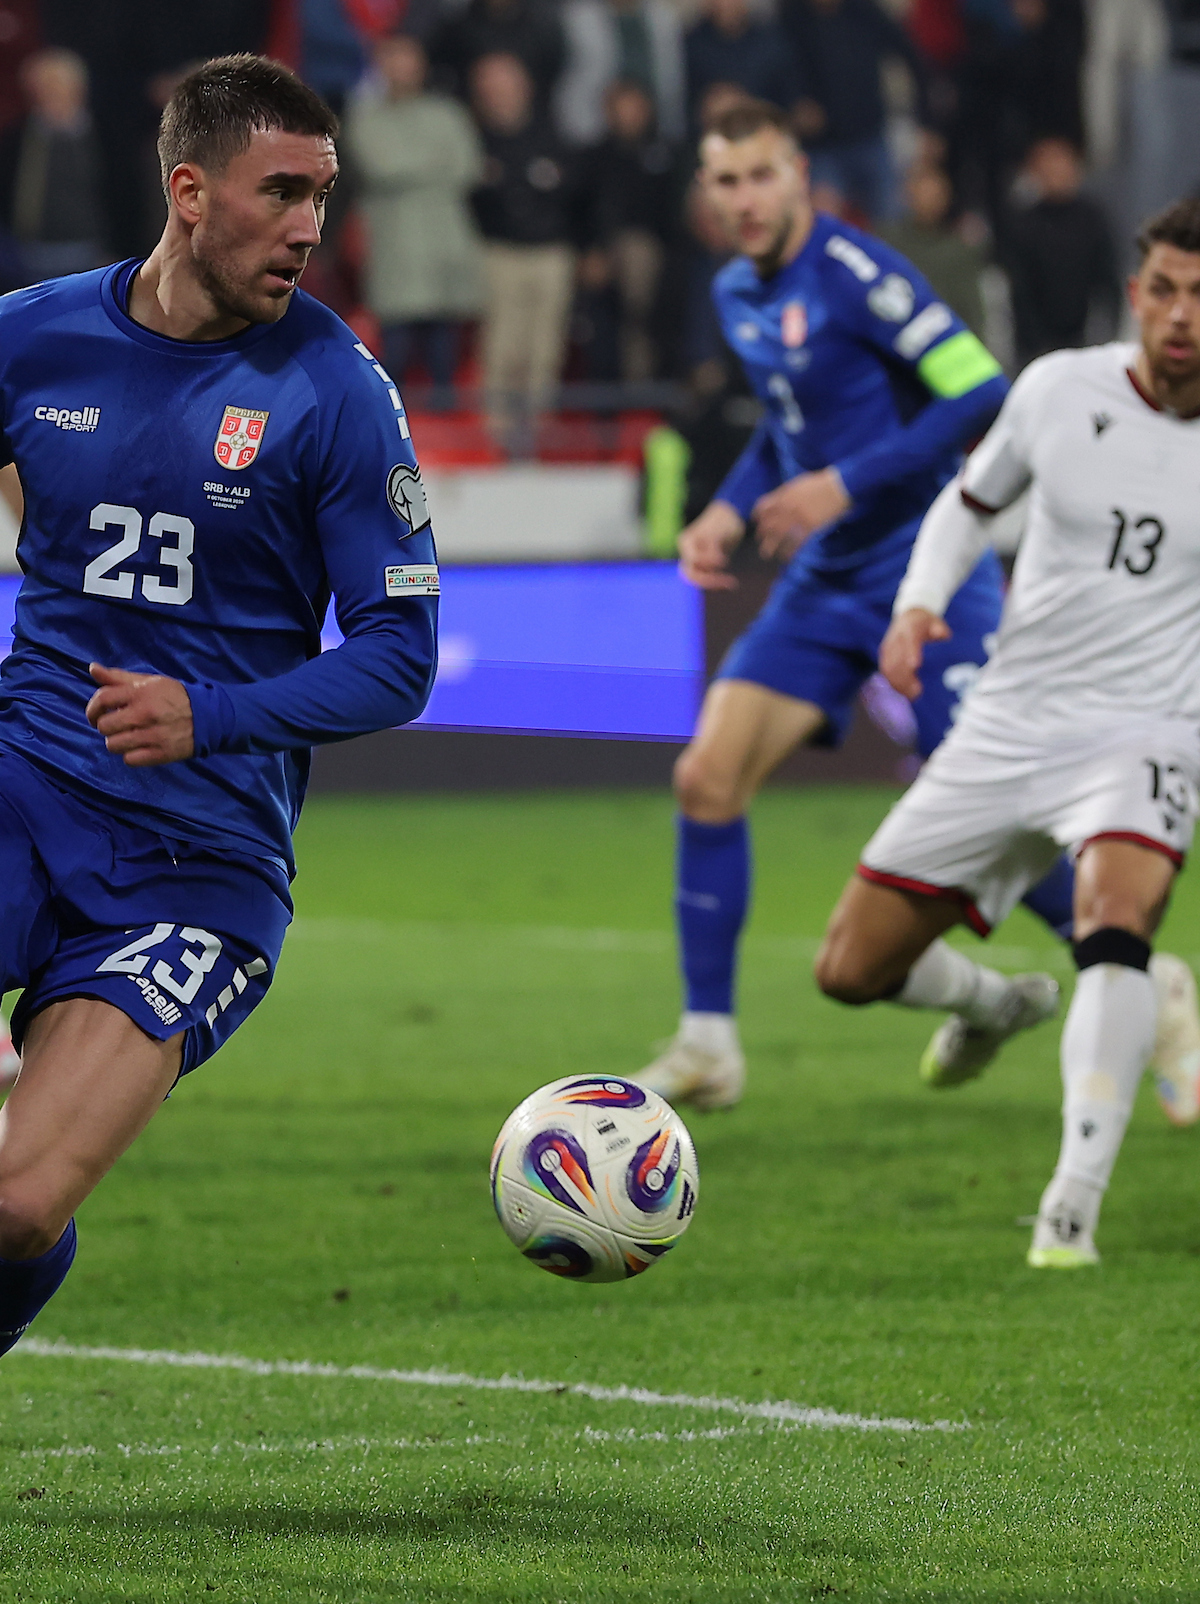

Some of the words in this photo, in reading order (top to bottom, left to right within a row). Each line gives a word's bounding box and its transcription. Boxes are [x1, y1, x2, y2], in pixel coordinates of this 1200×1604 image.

[34, 406, 101, 427] capelli
[226, 407, 266, 419] СРБИЈА
[61, 422, 97, 433] SPORT
[203, 481, 224, 494] SRB
[230, 486, 251, 498] ALB
[1107, 508, 1165, 576] 13
[82, 502, 196, 606] 23
[388, 575, 439, 585] FOUNDATIO
[94, 922, 224, 1005] 23
